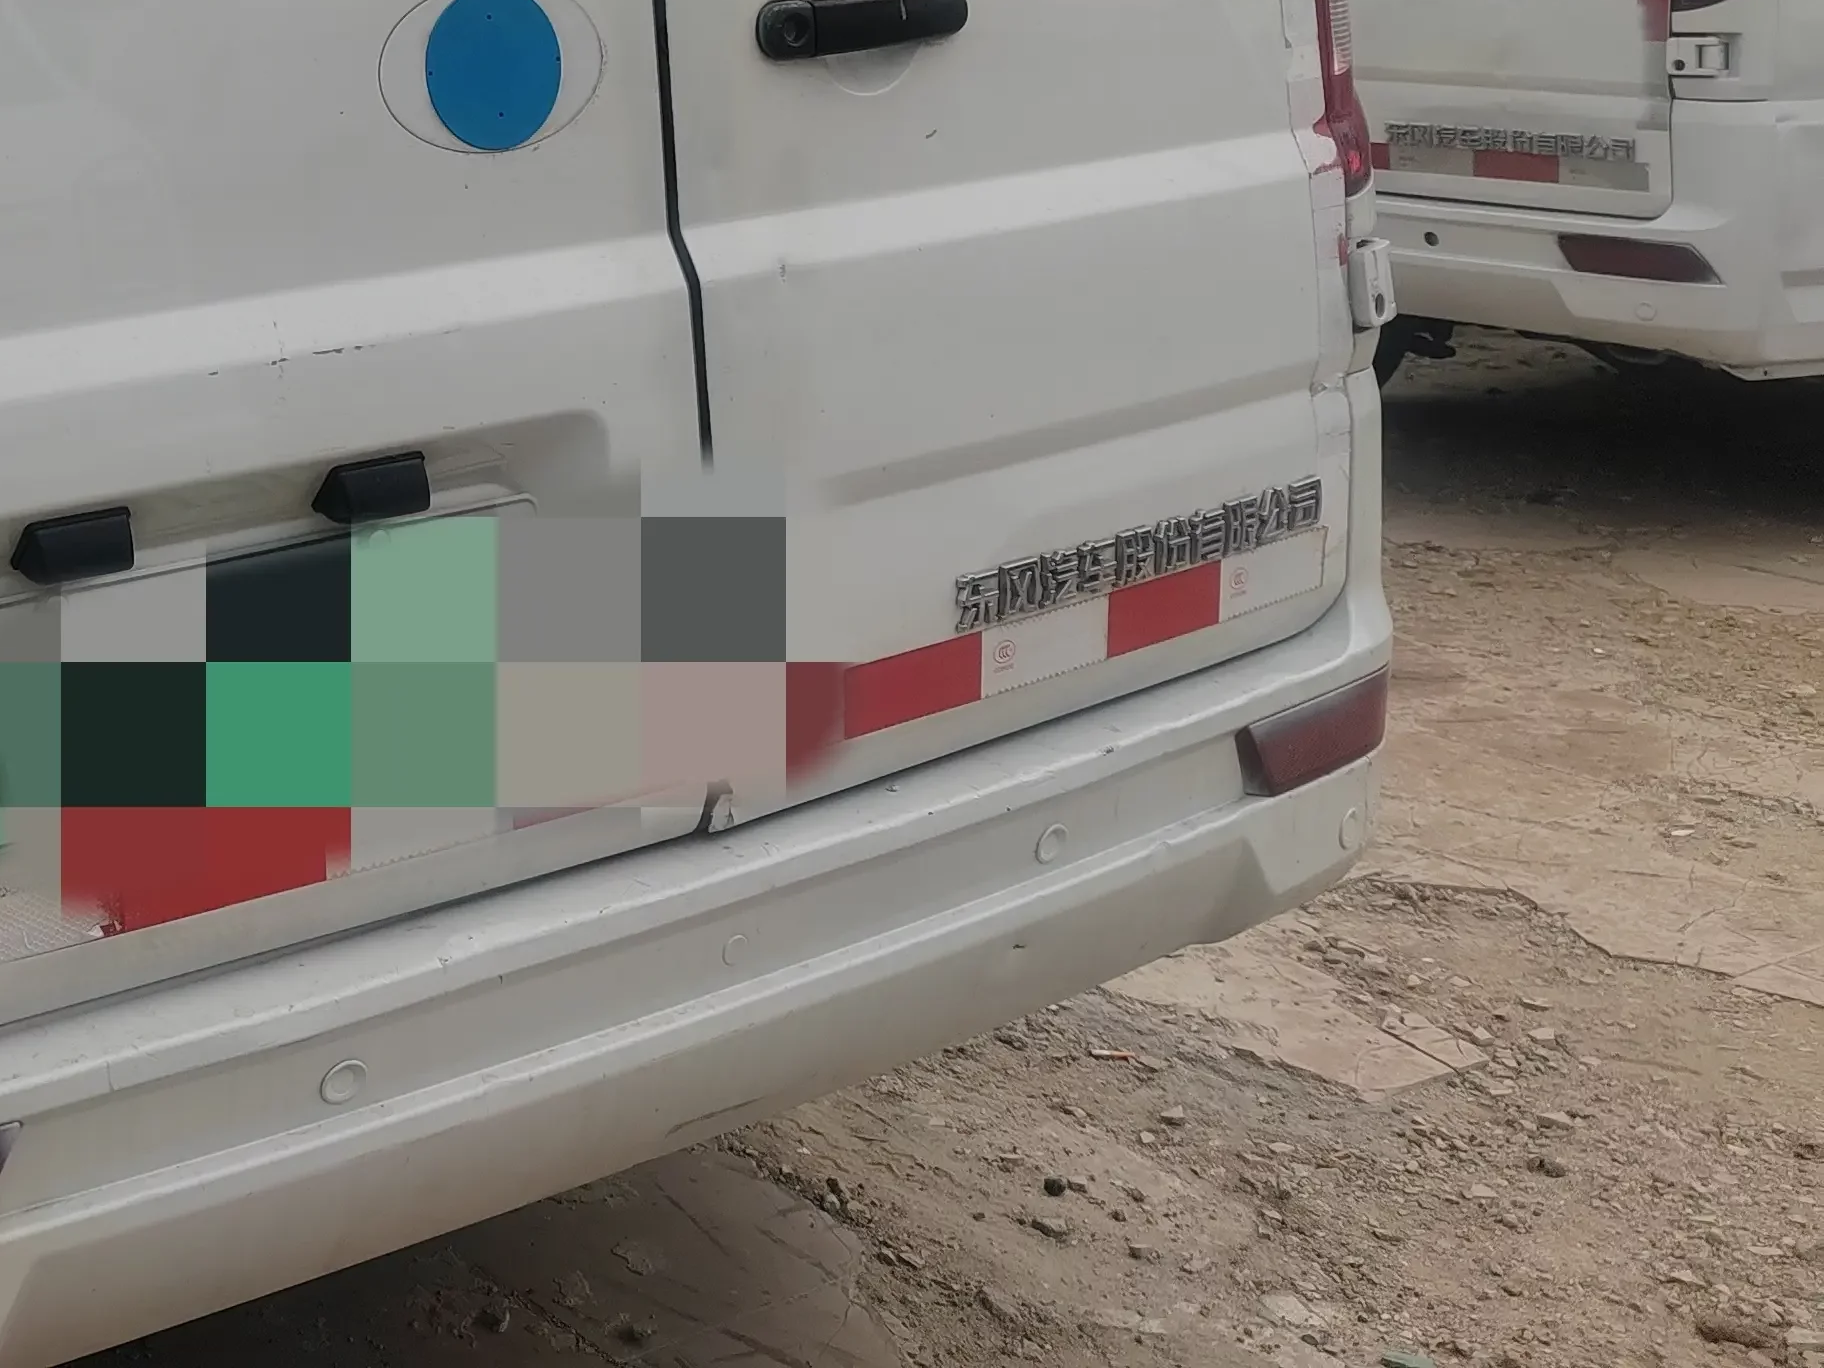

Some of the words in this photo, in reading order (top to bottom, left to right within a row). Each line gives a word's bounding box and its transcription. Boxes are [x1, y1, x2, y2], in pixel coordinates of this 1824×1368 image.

[1384, 119, 1636, 164] 东风汽车股份有限公司
[955, 473, 1324, 634] 东风汽车股份有限公司
